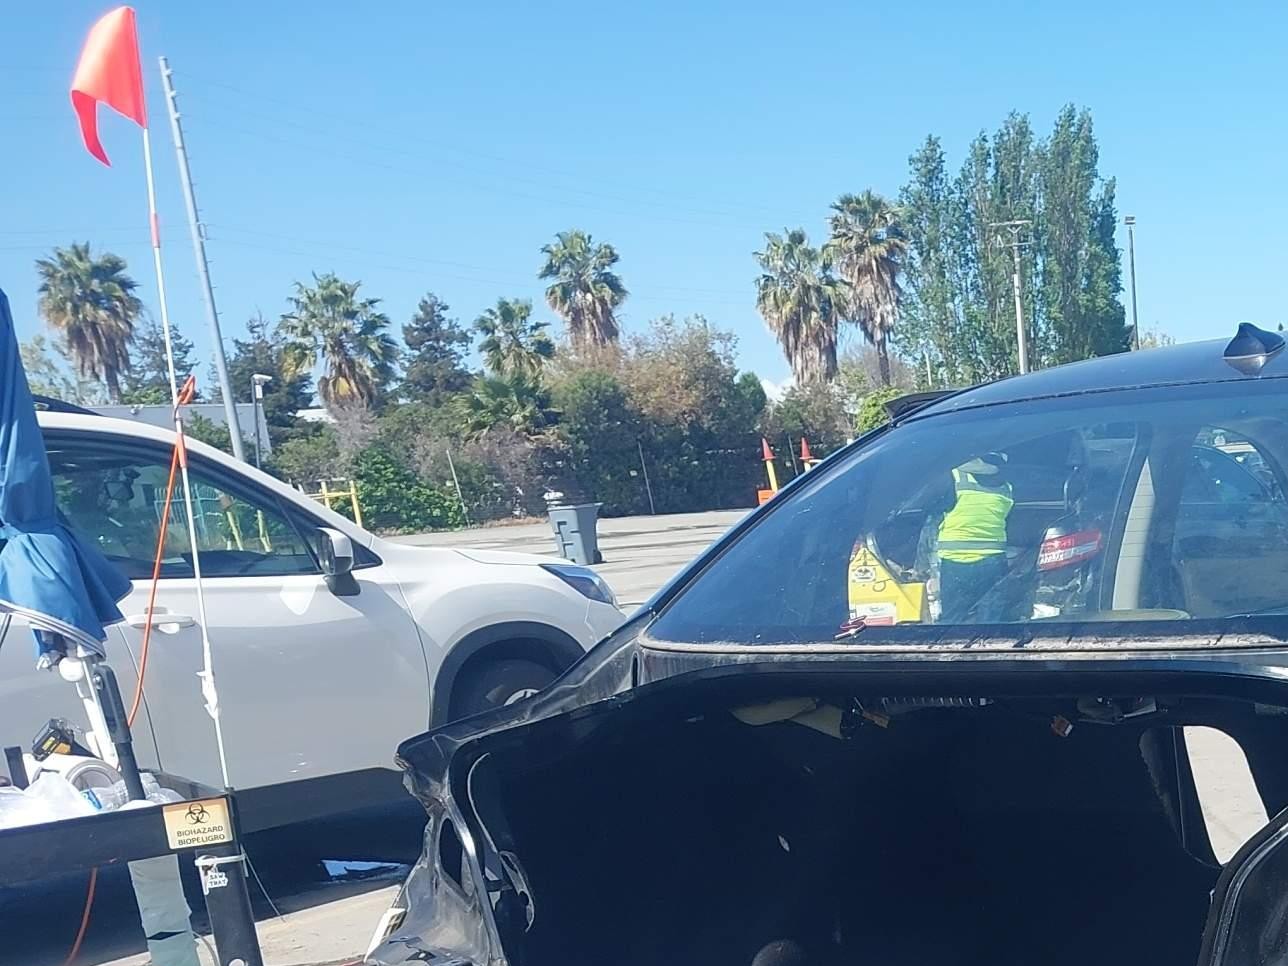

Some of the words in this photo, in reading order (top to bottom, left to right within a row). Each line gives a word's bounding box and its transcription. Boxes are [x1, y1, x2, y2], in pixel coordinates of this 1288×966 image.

[177, 825, 224, 837] BIOHAZARD
[178, 833, 226, 846] BIOPELIGRO
[209, 872, 225, 880] SAW
